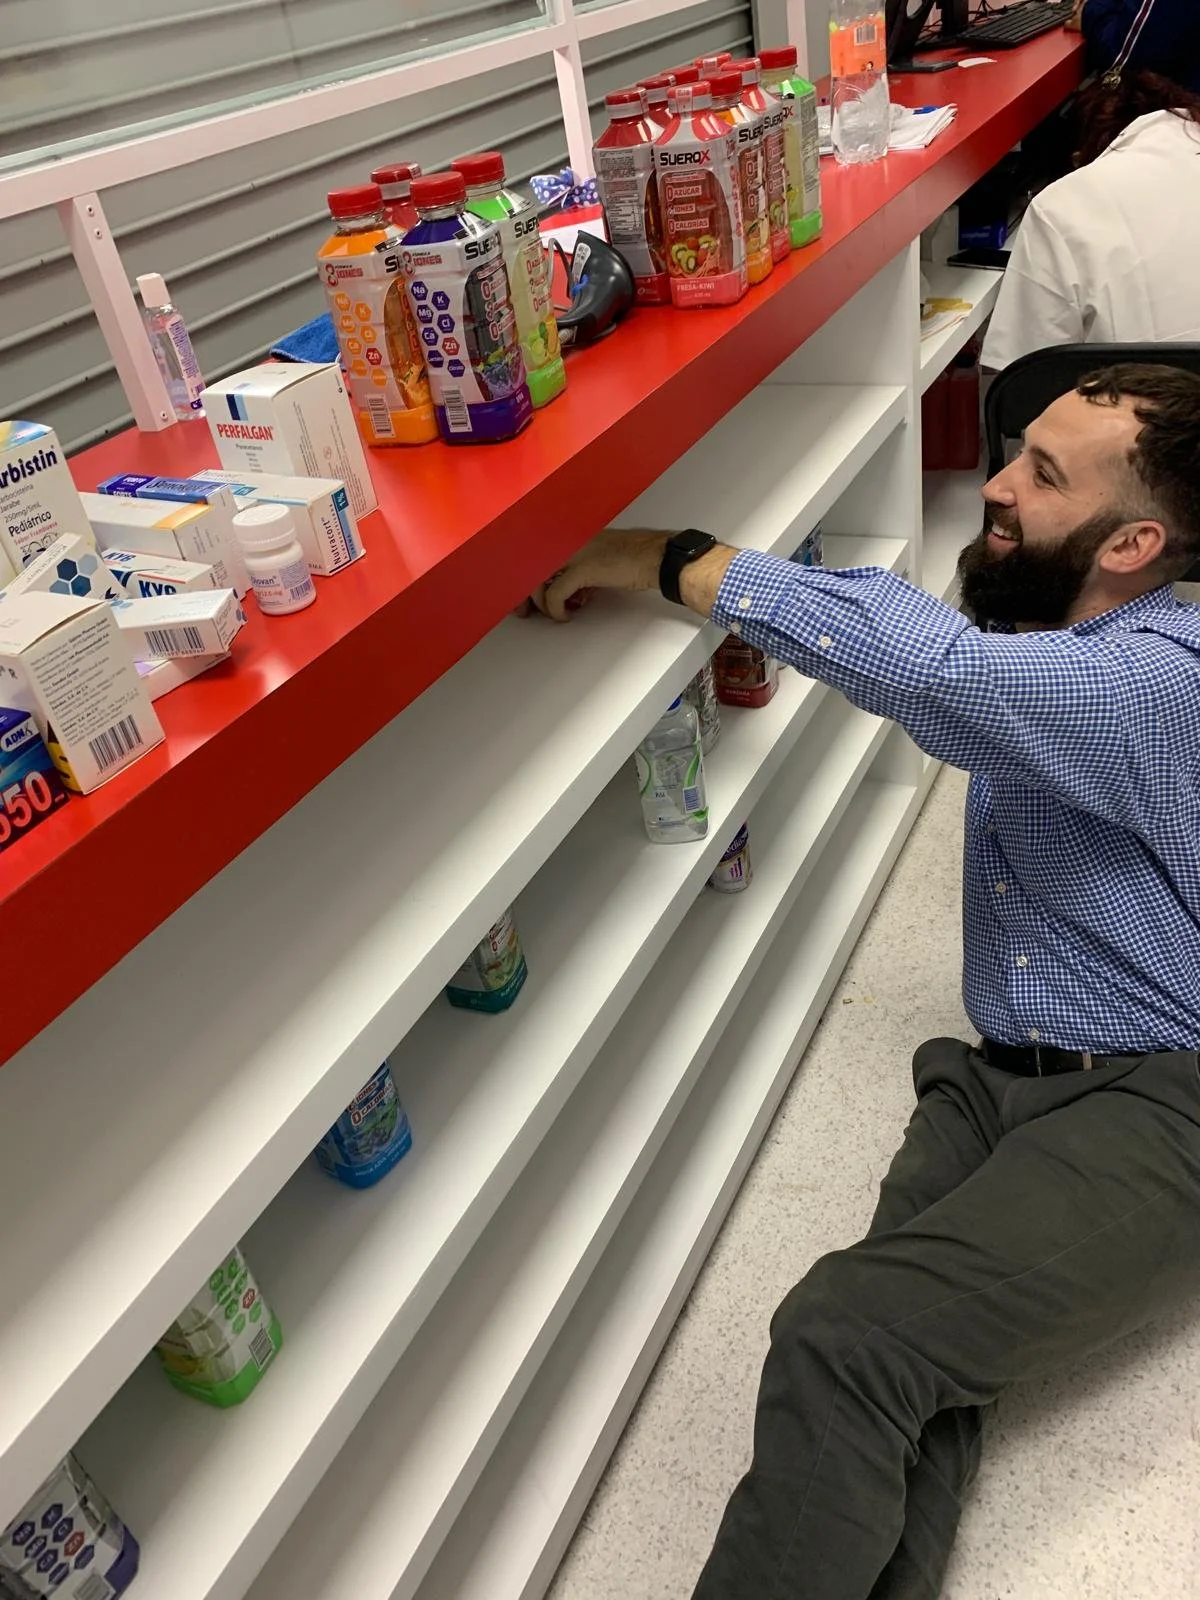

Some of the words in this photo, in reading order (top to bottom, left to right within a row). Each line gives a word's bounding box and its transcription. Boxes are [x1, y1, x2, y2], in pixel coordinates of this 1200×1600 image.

[660, 150, 710, 166] SUEROX
[413, 286, 425, 294] Na
[418, 309, 432, 318] Mg
[424, 332, 435, 340] Ca
[444, 341, 456, 350] Zn
[368, 352, 380, 360] Zn
[216, 423, 274, 441] PERFALGAN
[8, 510, 52, 538] Pediátrico
[322, 520, 342, 566] Nutracort
[5, 728, 24, 748] ADN
